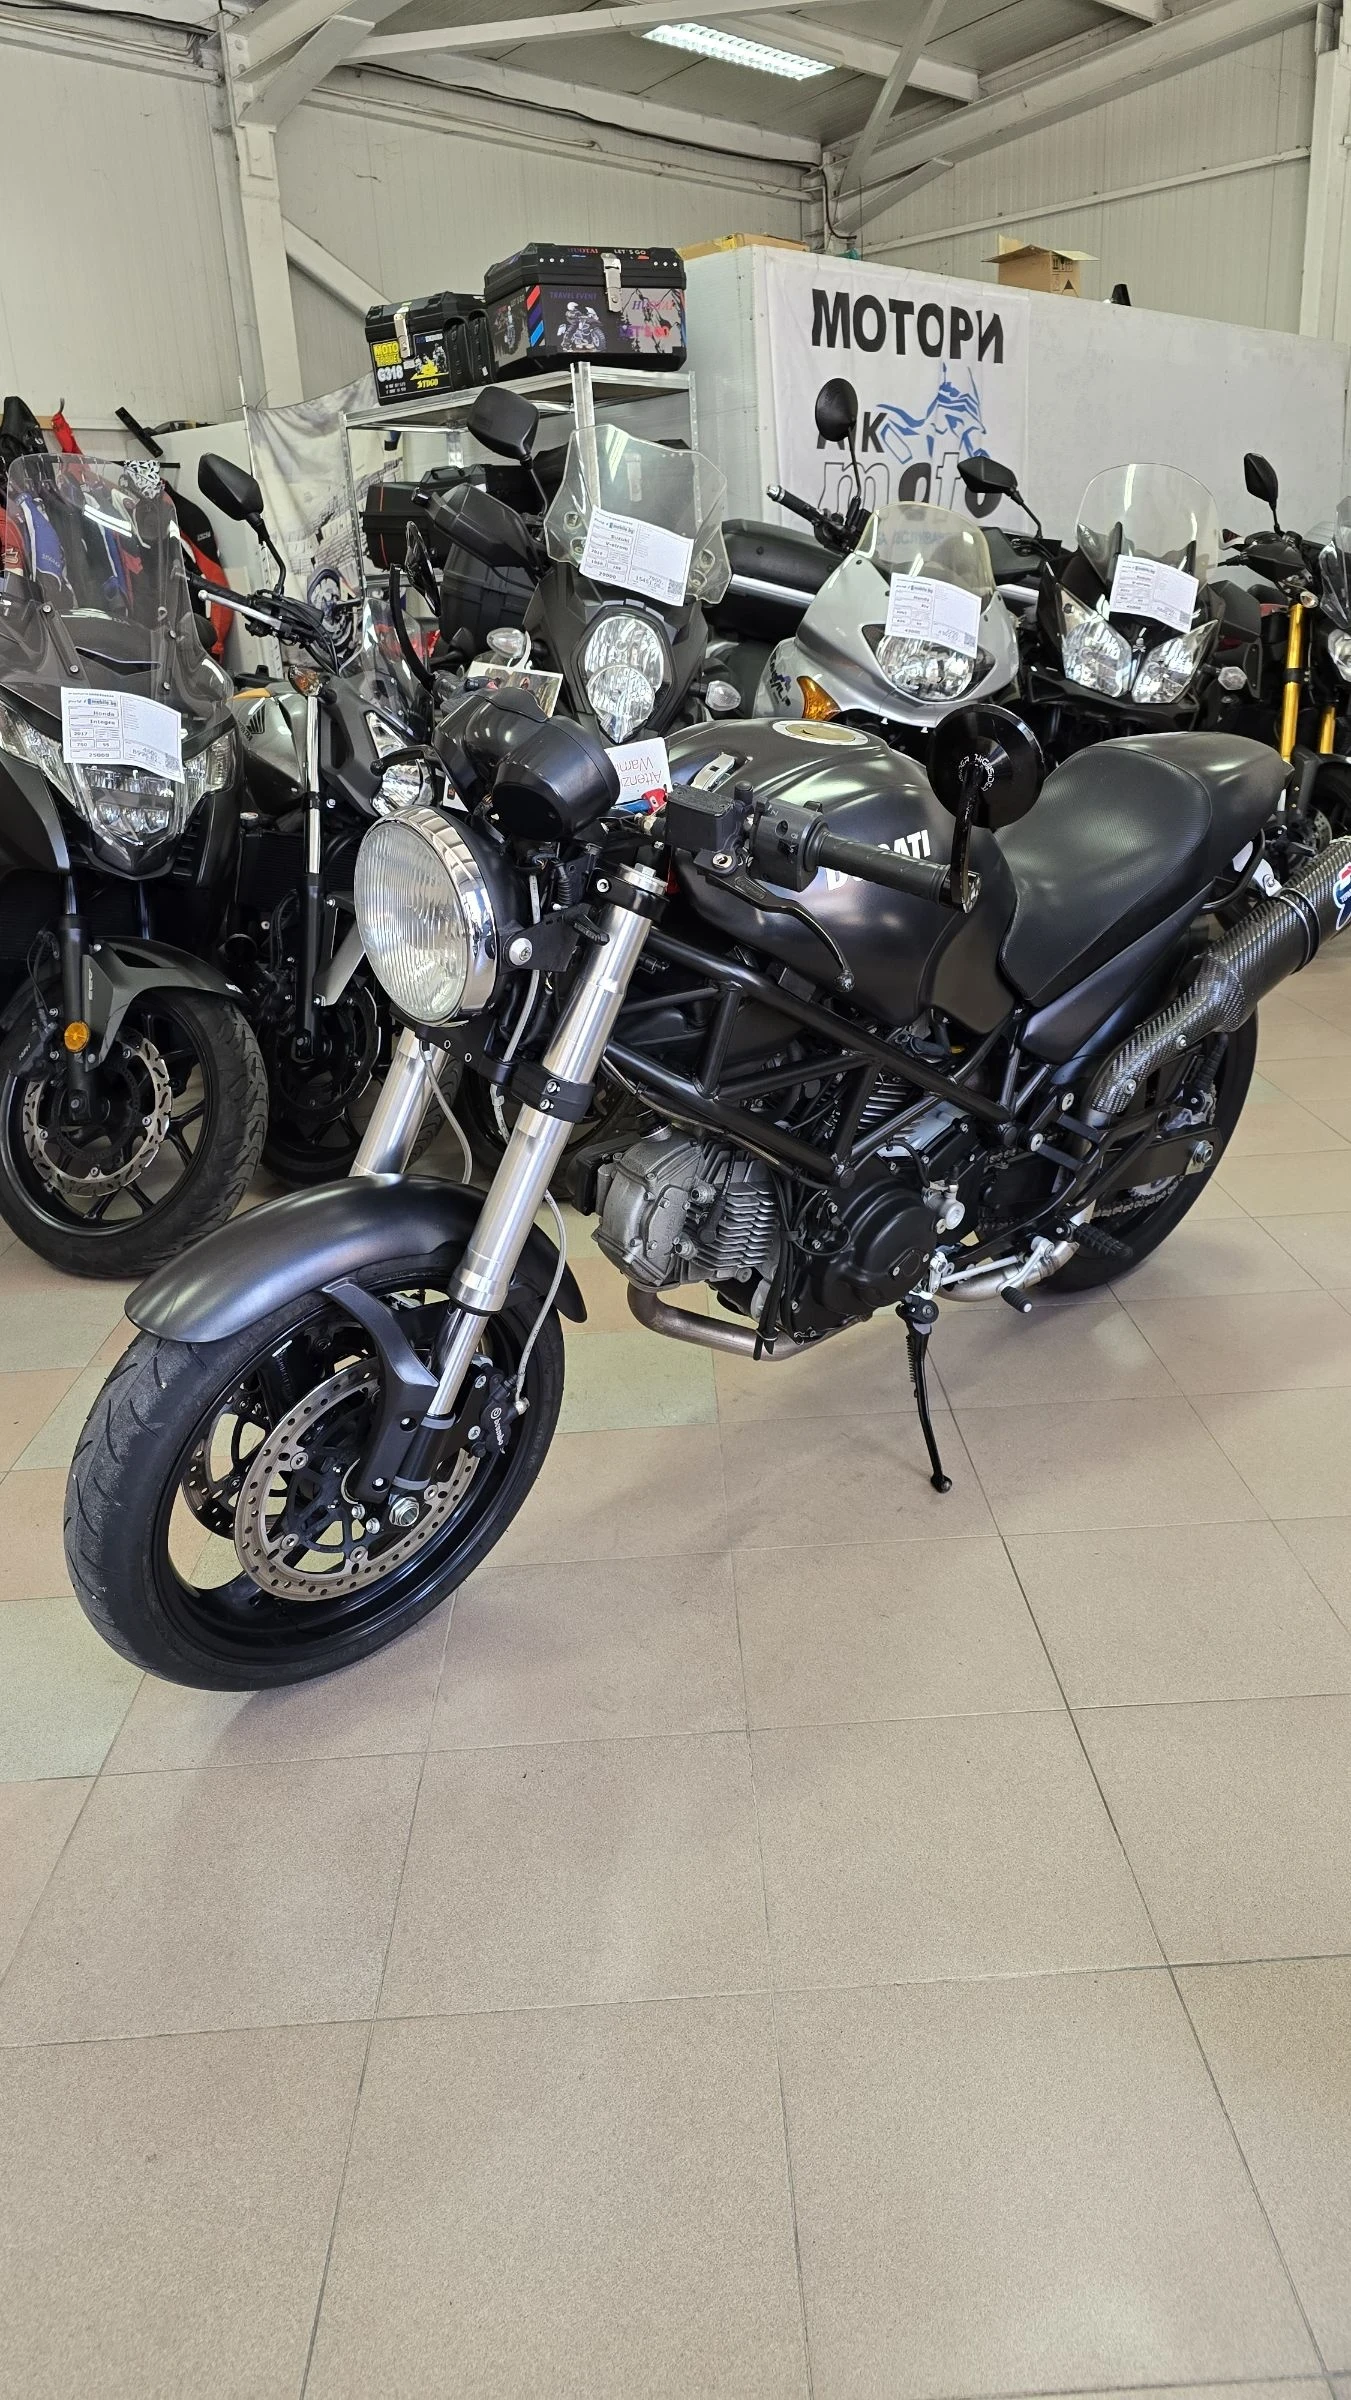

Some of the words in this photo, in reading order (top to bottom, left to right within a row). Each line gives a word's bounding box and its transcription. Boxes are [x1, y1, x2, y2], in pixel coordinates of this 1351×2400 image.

[811, 288, 1004, 364] МОТОРИ
[374, 340, 400, 354] MOTO
[615, 756, 654, 771] Warni
[620, 769, 662, 788] Attenzi
[824, 829, 932, 892] DATI
[493, 1417, 505, 1446] brembo
